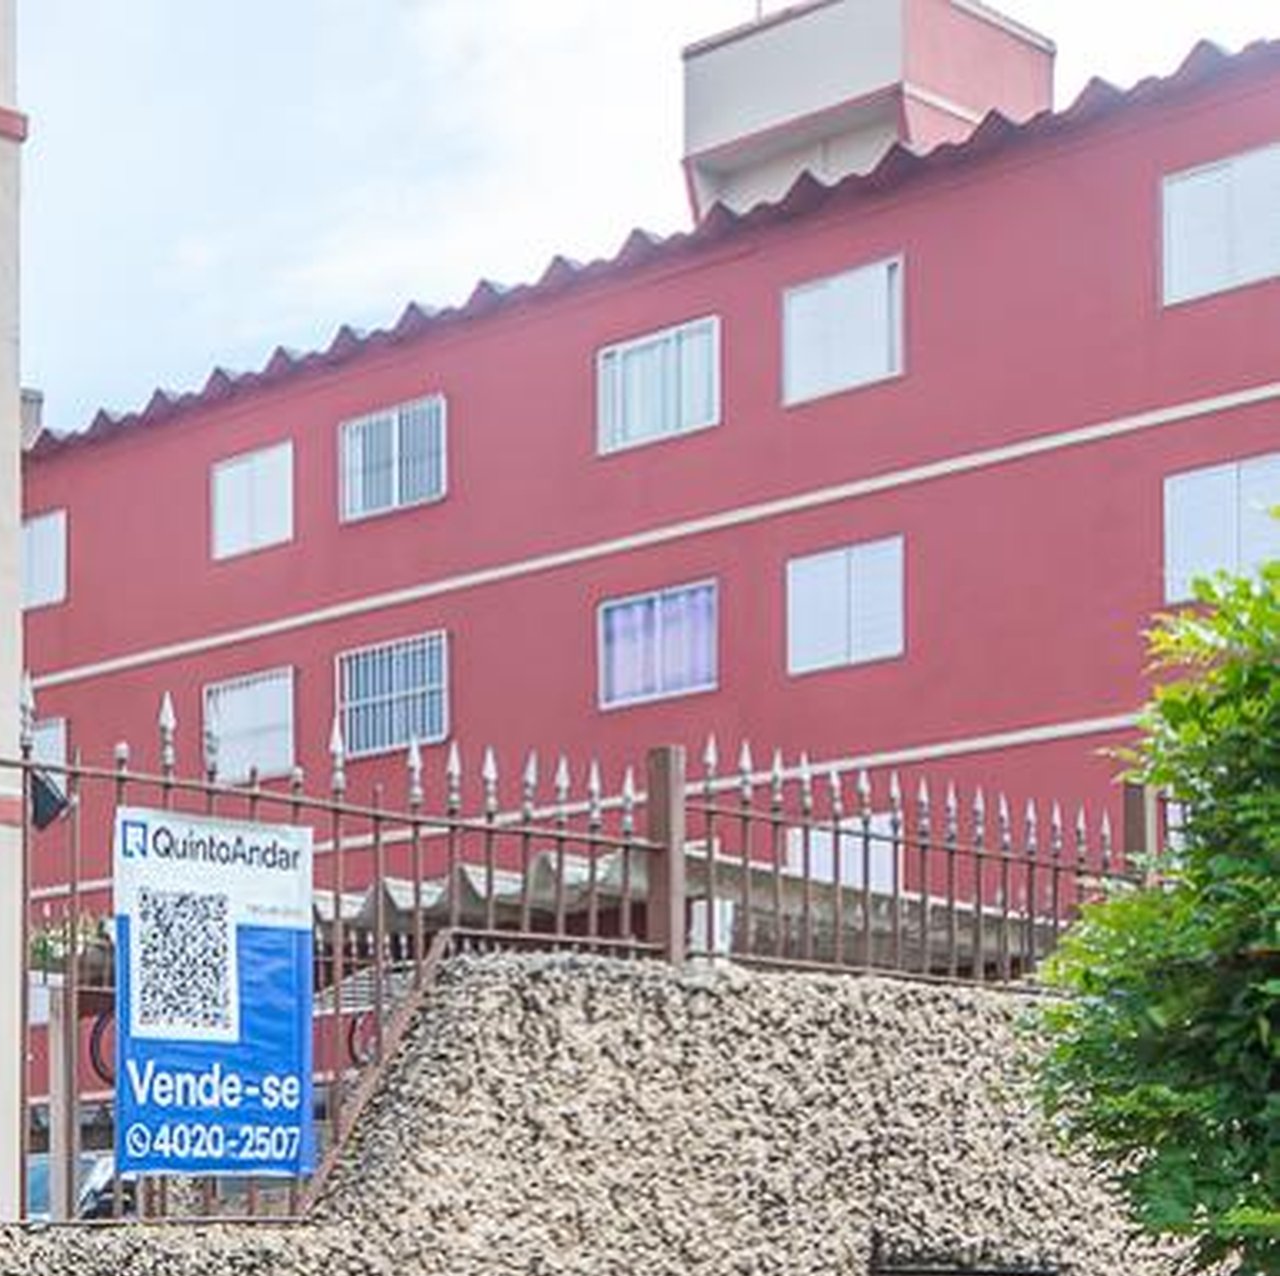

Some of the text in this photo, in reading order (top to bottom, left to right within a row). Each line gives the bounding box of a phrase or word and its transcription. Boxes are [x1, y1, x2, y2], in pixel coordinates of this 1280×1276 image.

[152, 827, 301, 870] QuintoAndar
[126, 1058, 301, 1110] Vende-se
[153, 1123, 300, 1161] 4020-2507
